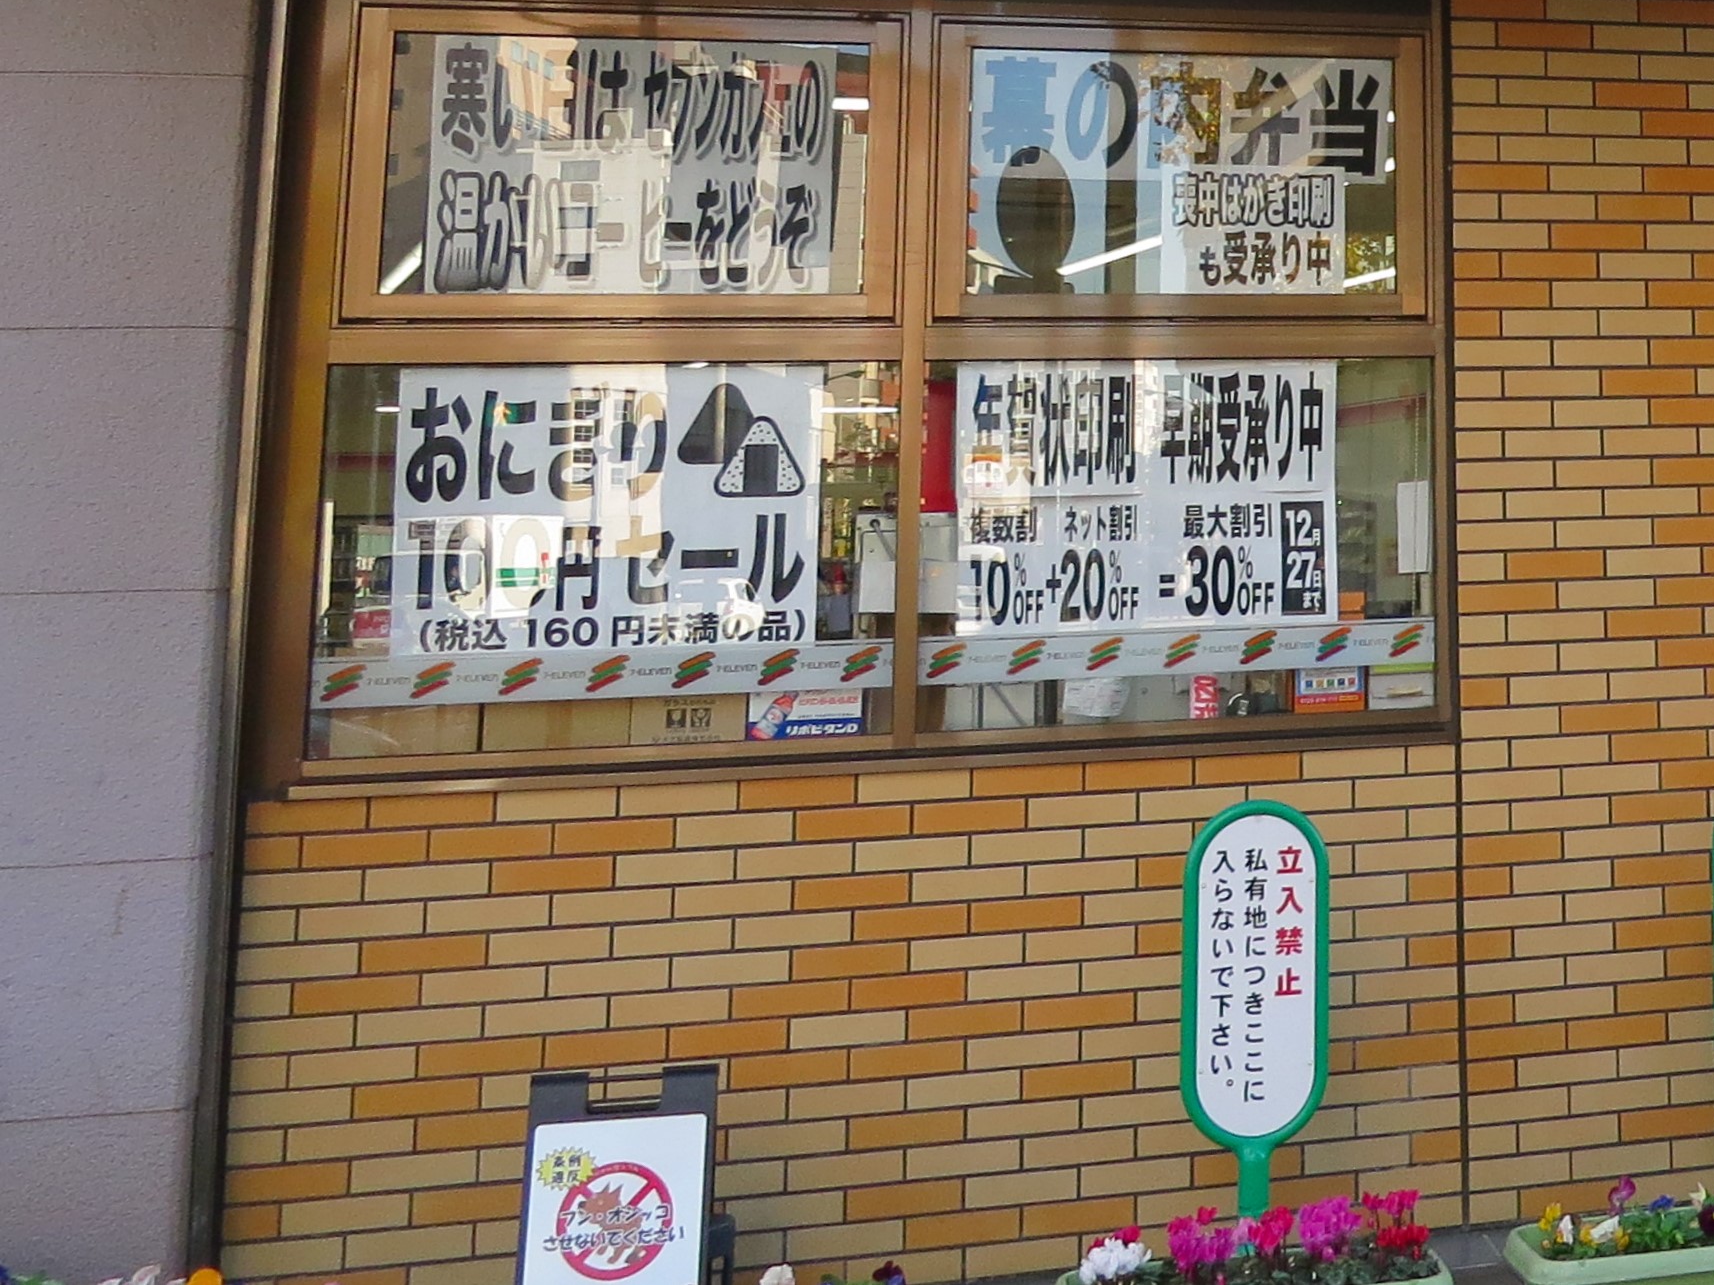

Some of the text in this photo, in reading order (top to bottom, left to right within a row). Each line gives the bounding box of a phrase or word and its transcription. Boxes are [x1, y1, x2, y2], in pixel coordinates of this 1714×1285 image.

[981, 56, 1379, 176] 幕の内弁当
[1173, 172, 1334, 228] 喪中はがき印刷
[1199, 231, 1331, 286] も受承り中
[406, 387, 667, 503] おにぎり
[973, 371, 1323, 486] 年賀状印刷 早期受承り中
[1064, 504, 1138, 542] ネット割引
[1183, 503, 1272, 540] 最大割引
[1286, 509, 1321, 546] 12月
[1286, 551, 1322, 589] 27日
[1302, 591, 1322, 611] まで
[785, 723, 858, 737] リポビタンD
[1274, 846, 1303, 997] 立入禁止
[1210, 850, 1236, 1088] 入らないで下さい。
[1243, 847, 1268, 1102] 私有地につきここに
[542, 1226, 686, 1252] させないでください
[562, 1204, 669, 1227] フン・オシッコ
